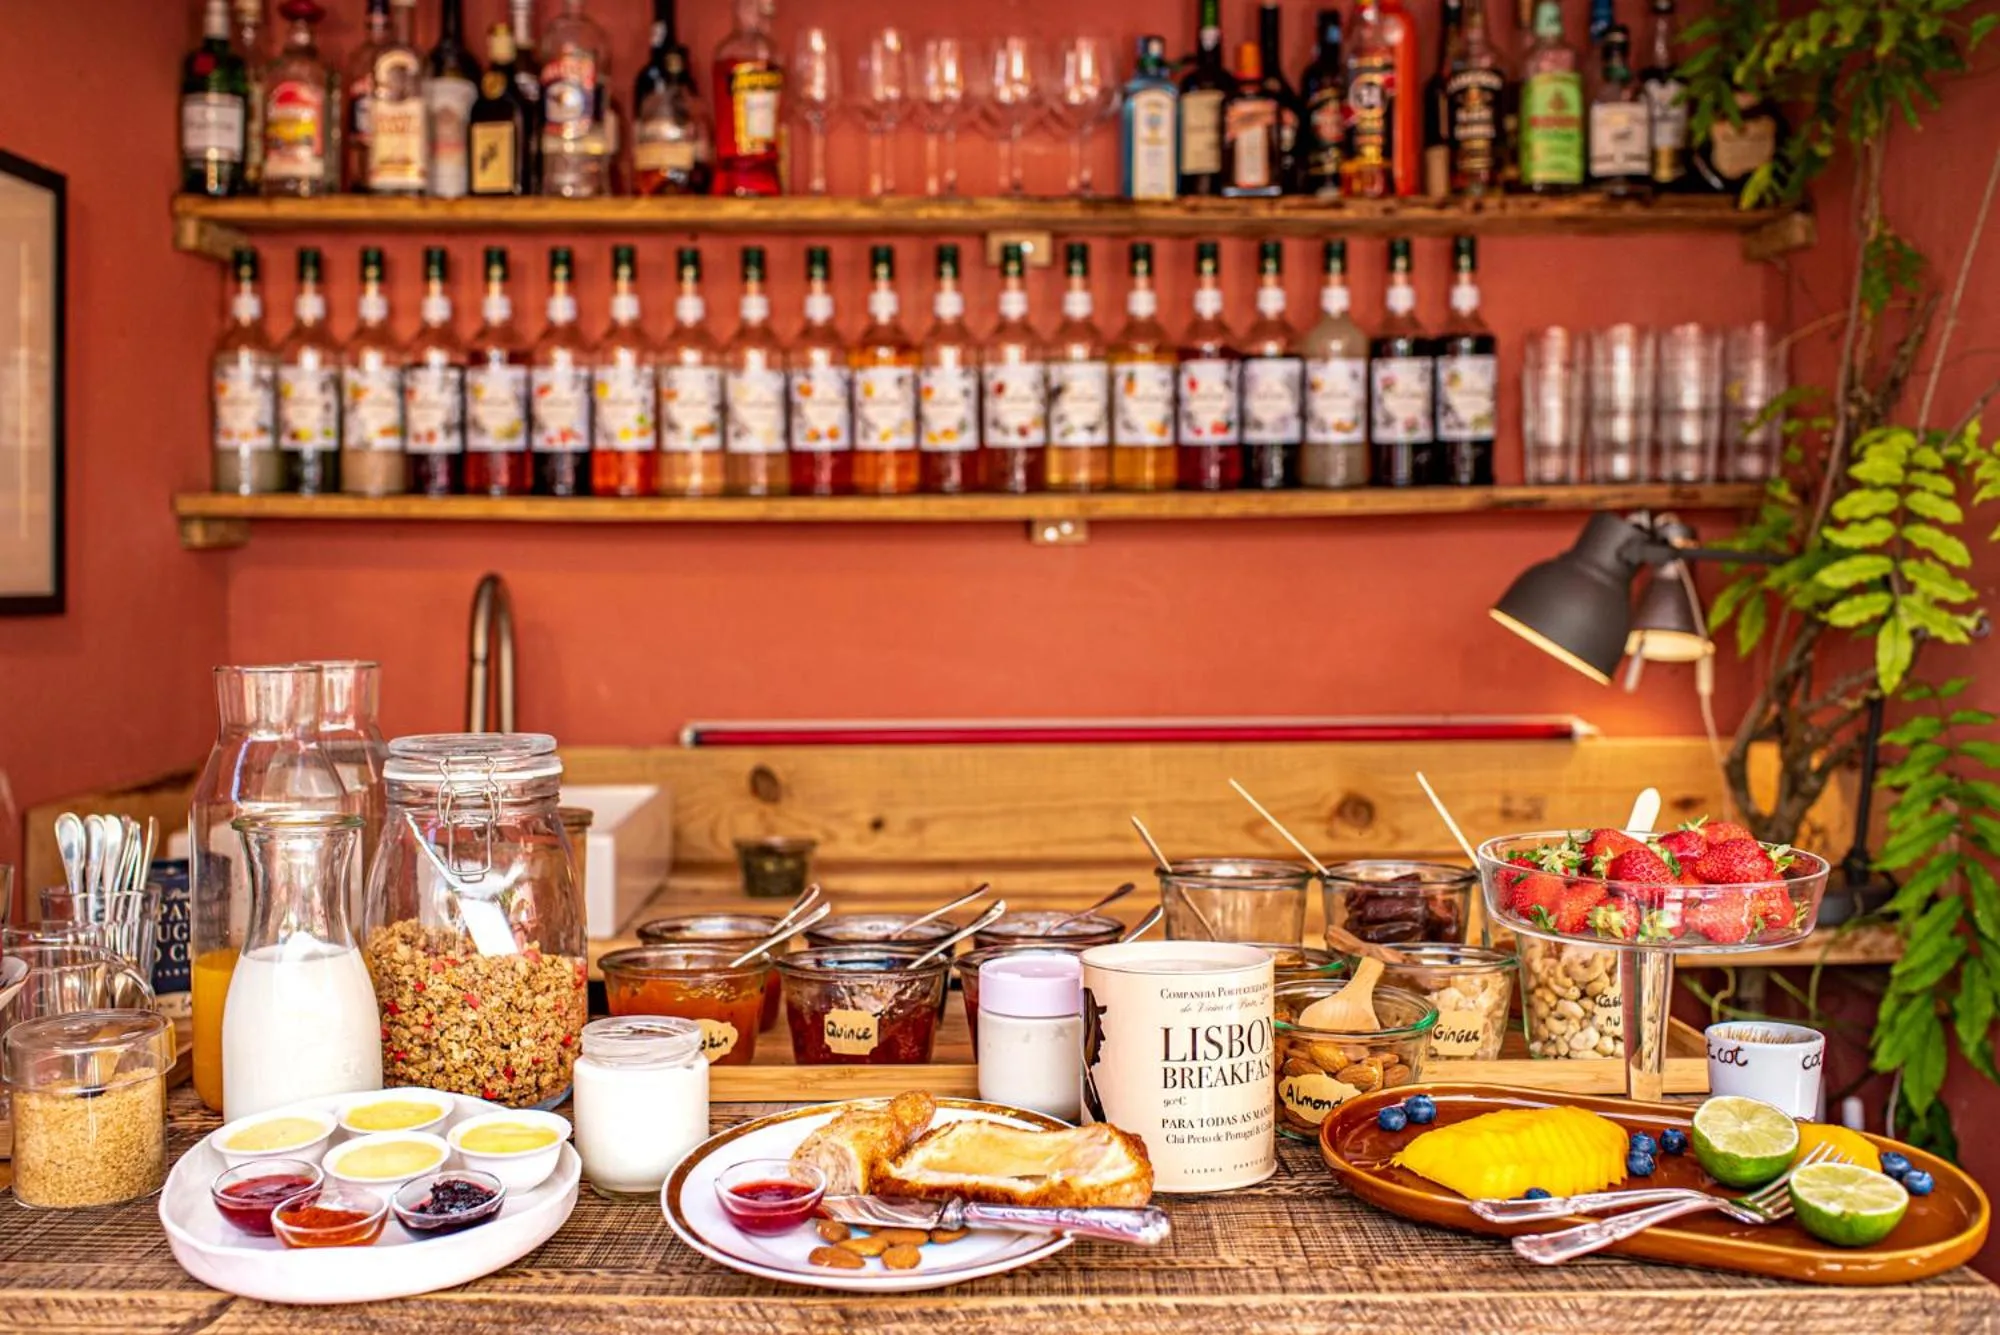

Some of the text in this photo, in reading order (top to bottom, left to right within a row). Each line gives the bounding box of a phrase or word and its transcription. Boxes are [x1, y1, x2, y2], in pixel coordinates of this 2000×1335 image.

[826, 1020, 873, 1042] Quince
[1161, 1117, 1195, 1129] PARA
[1196, 1114, 1238, 1129] TODAS
[1240, 1111, 1252, 1124] AS
